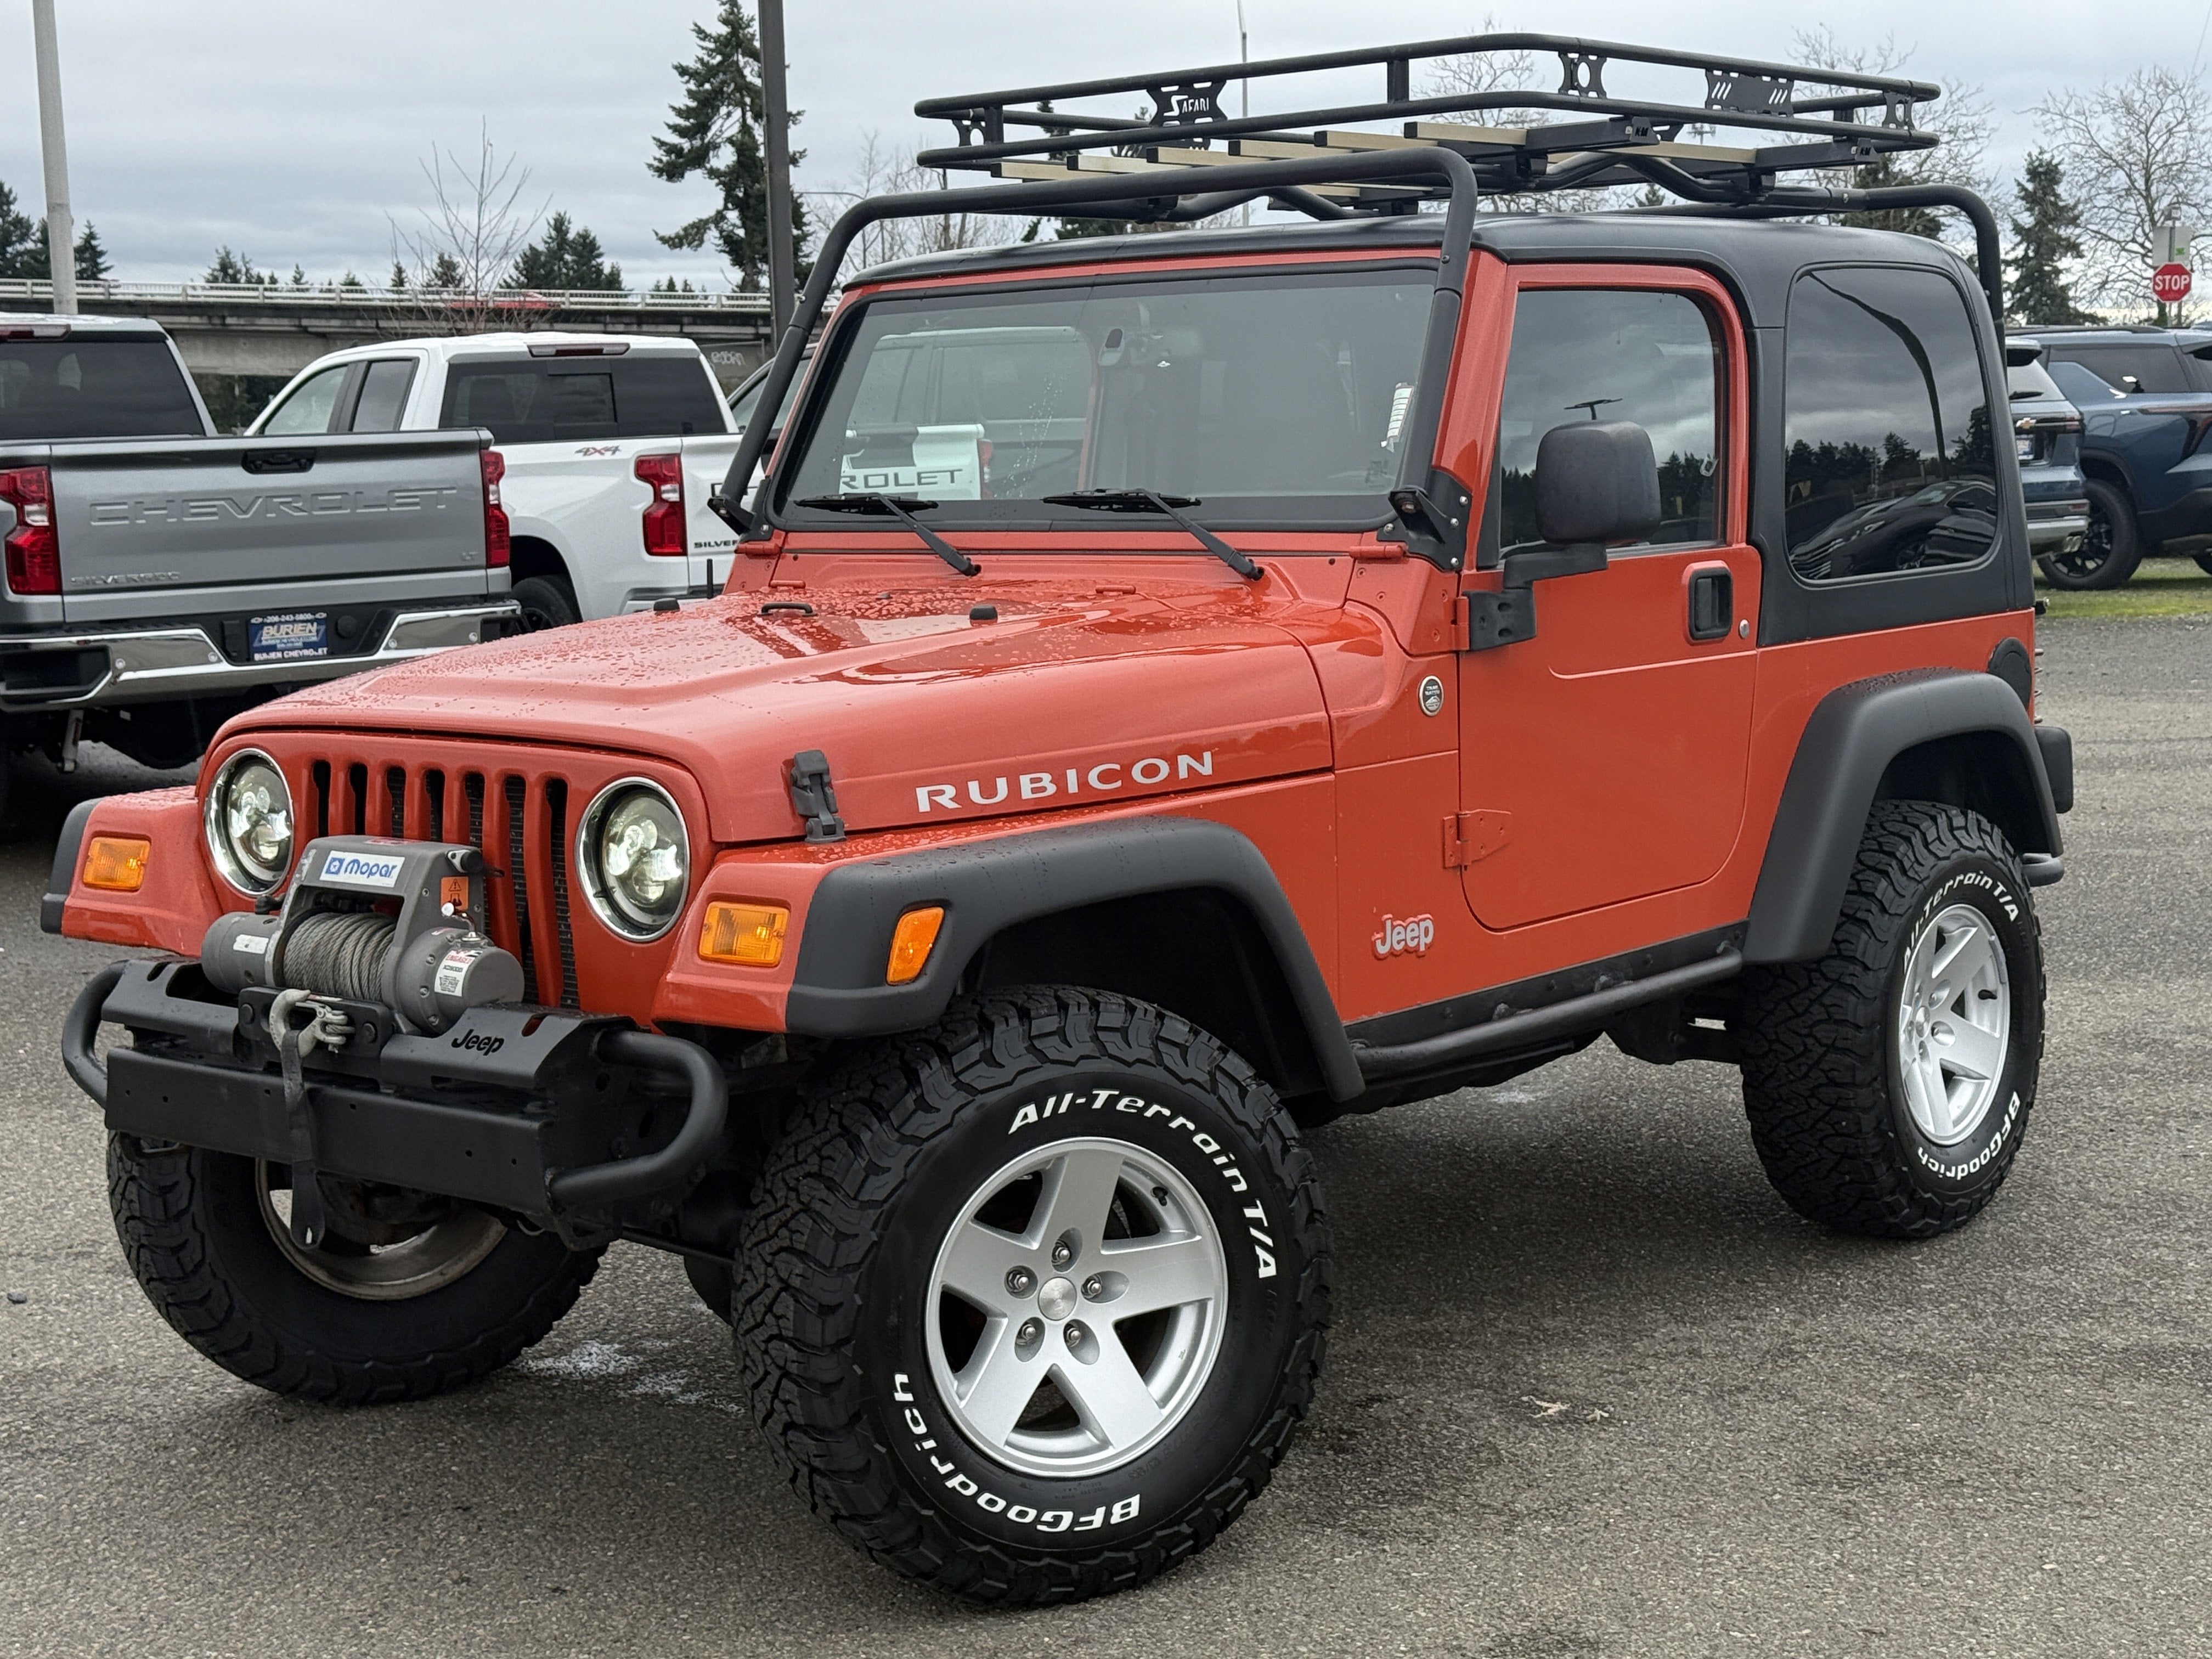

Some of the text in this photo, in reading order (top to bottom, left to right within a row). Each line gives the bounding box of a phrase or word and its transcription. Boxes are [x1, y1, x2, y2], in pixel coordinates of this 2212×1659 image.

[1163, 95, 1209, 116] SAFARI
[2154, 275, 2190, 291] STOP
[89, 487, 458, 526] CHEVROLET
[262, 622, 317, 637] BURIEN
[915, 751, 1214, 812] RUBICON
[344, 859, 397, 879] Mopar
[1993, 882, 2019, 922] T/A
[1374, 916, 1434, 955] Jeep
[451, 1029, 505, 1056] Jeep
[1918, 1091, 2020, 1180] BFGoodrich
[1007, 1088, 1277, 1279] All-Terrain T/A
[893, 1372, 1141, 1532] BFGoodrich
